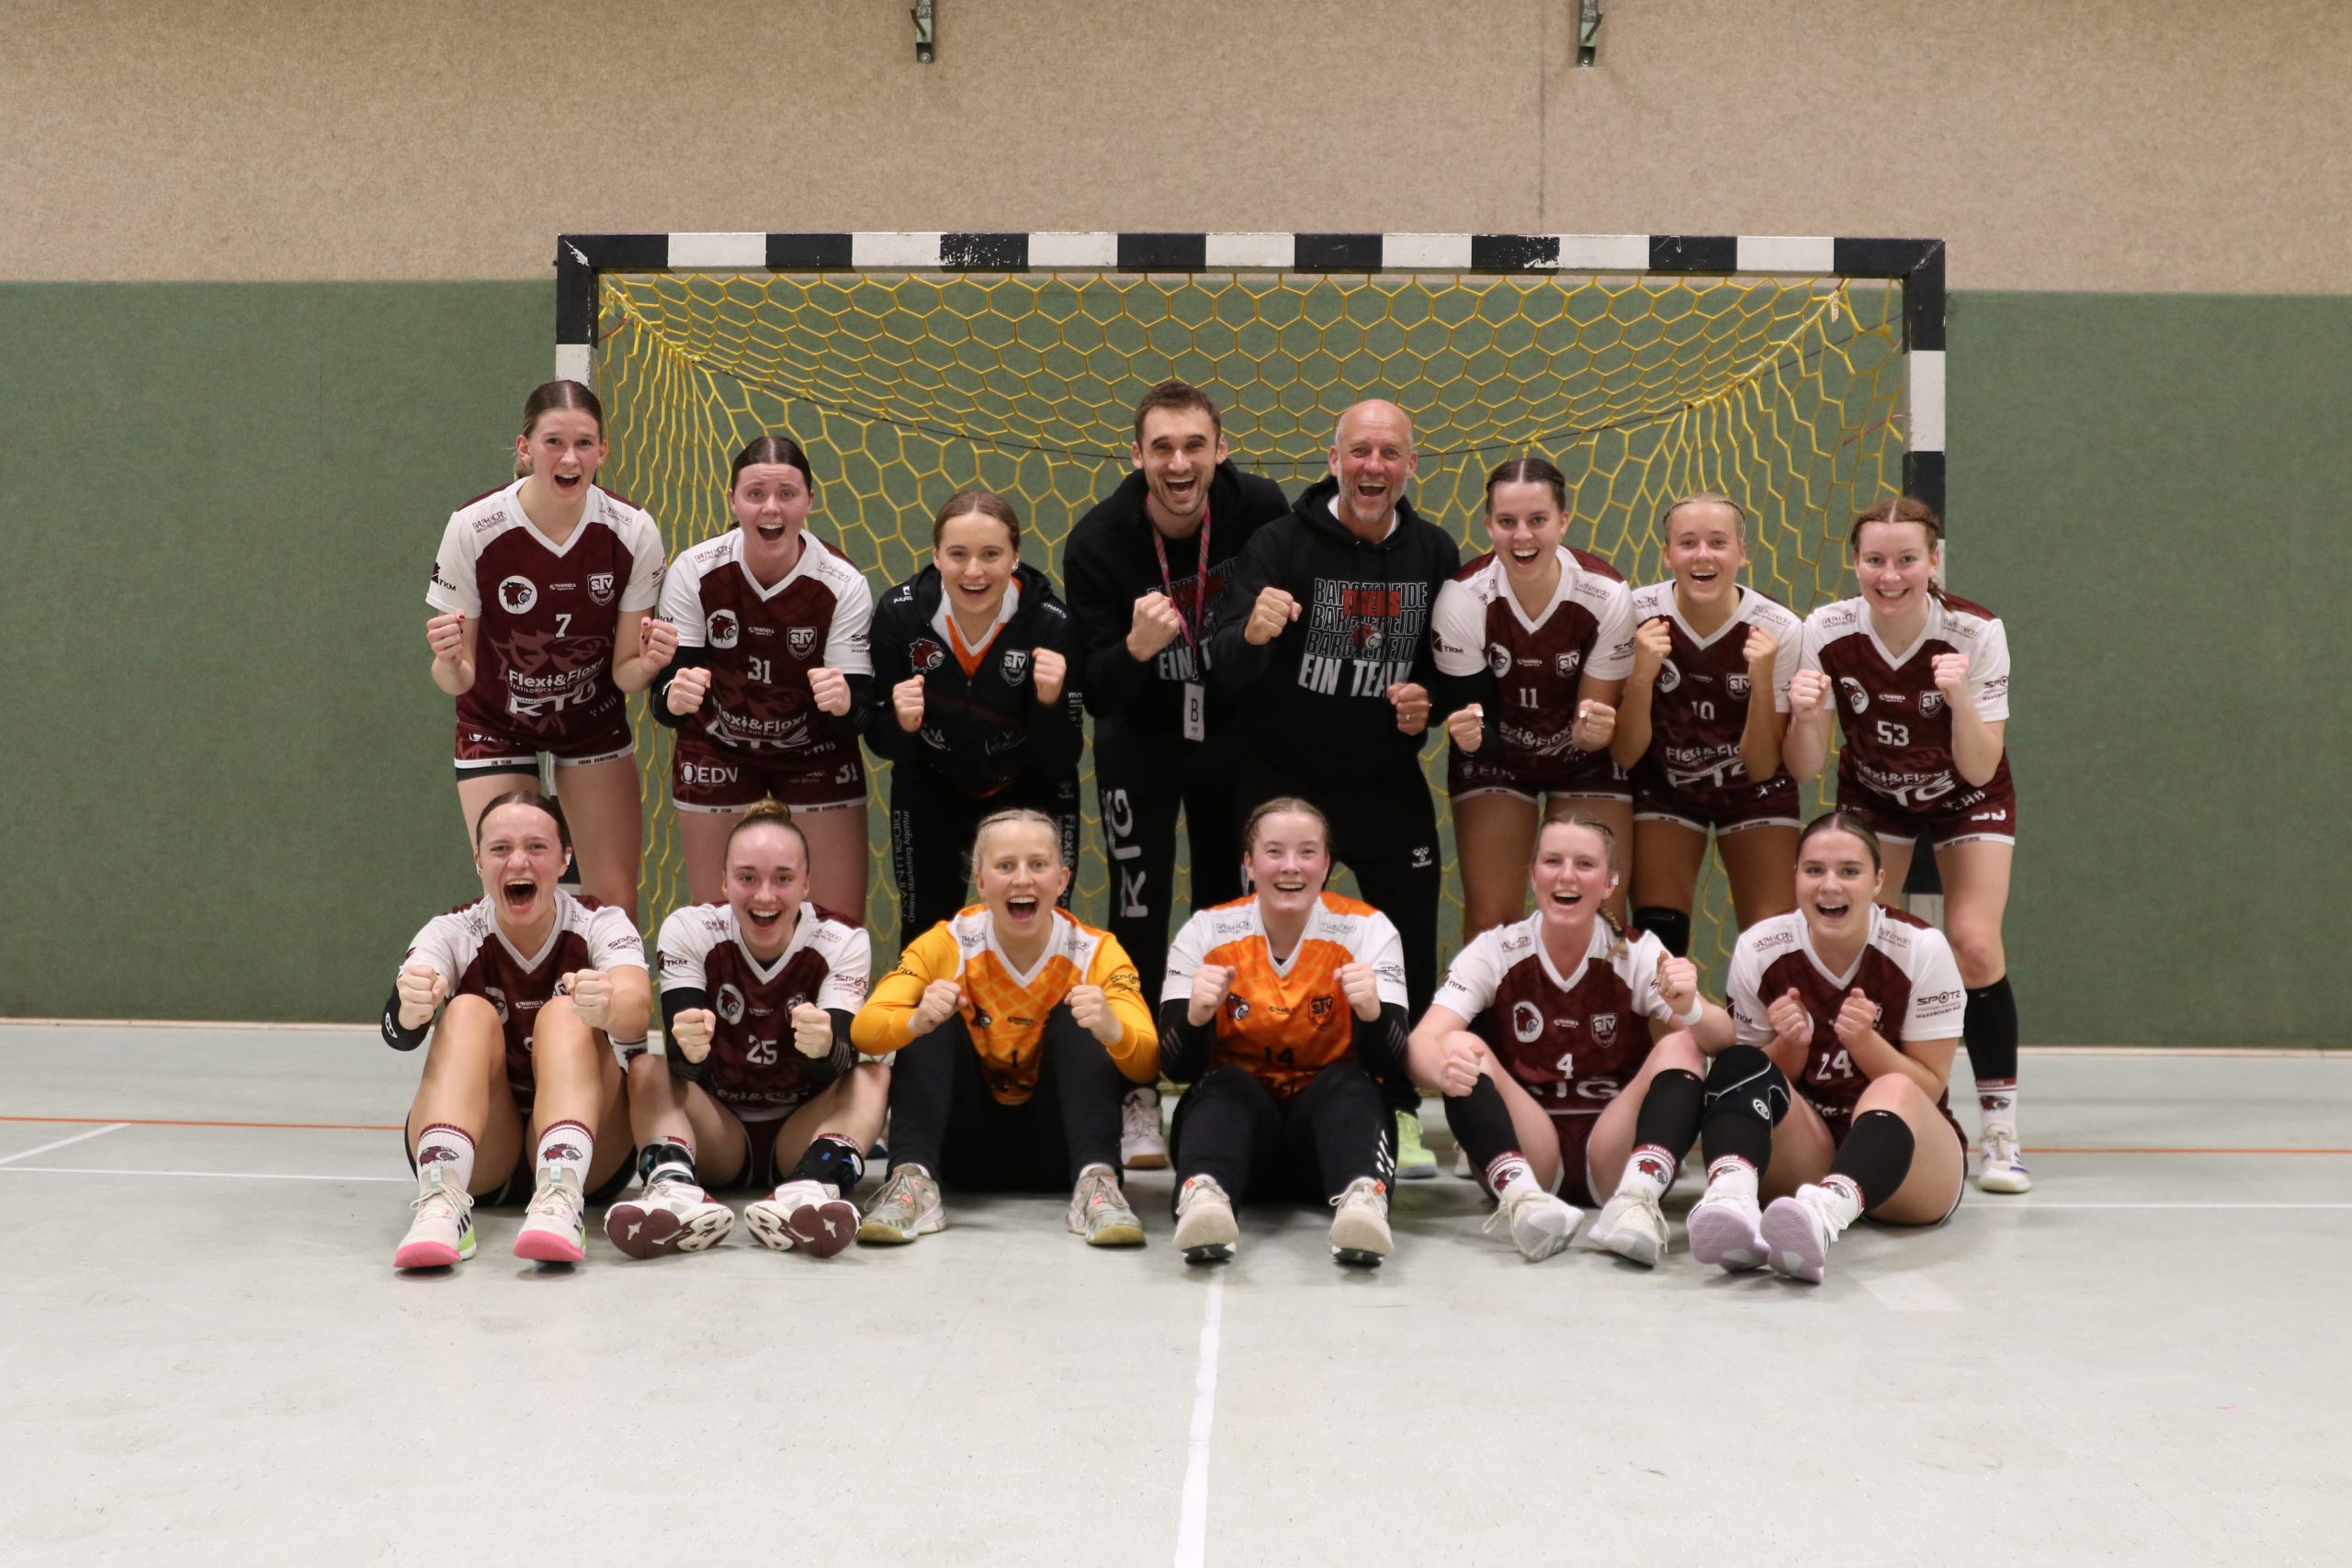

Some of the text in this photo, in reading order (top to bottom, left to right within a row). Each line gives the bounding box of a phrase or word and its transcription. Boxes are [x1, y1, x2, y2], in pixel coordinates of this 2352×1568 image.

[439, 580, 457, 592] TKM
[556, 614, 571, 637] 7
[748, 655, 773, 684] 31
[1159, 646, 1193, 680] EIN
[1297, 653, 1341, 696] EIN
[1520, 688, 1539, 709] 11
[1691, 701, 1715, 720] 10
[1877, 720, 1909, 746] 53
[901, 810, 911, 844] Agentur
[903, 847, 915, 891] Marketing
[1449, 980, 1466, 992] TKM
[1736, 1012, 1752, 1024] TKM
[746, 1034, 777, 1065] 25
[1556, 1053, 1573, 1079] 4
[1816, 1050, 1854, 1080] 24
